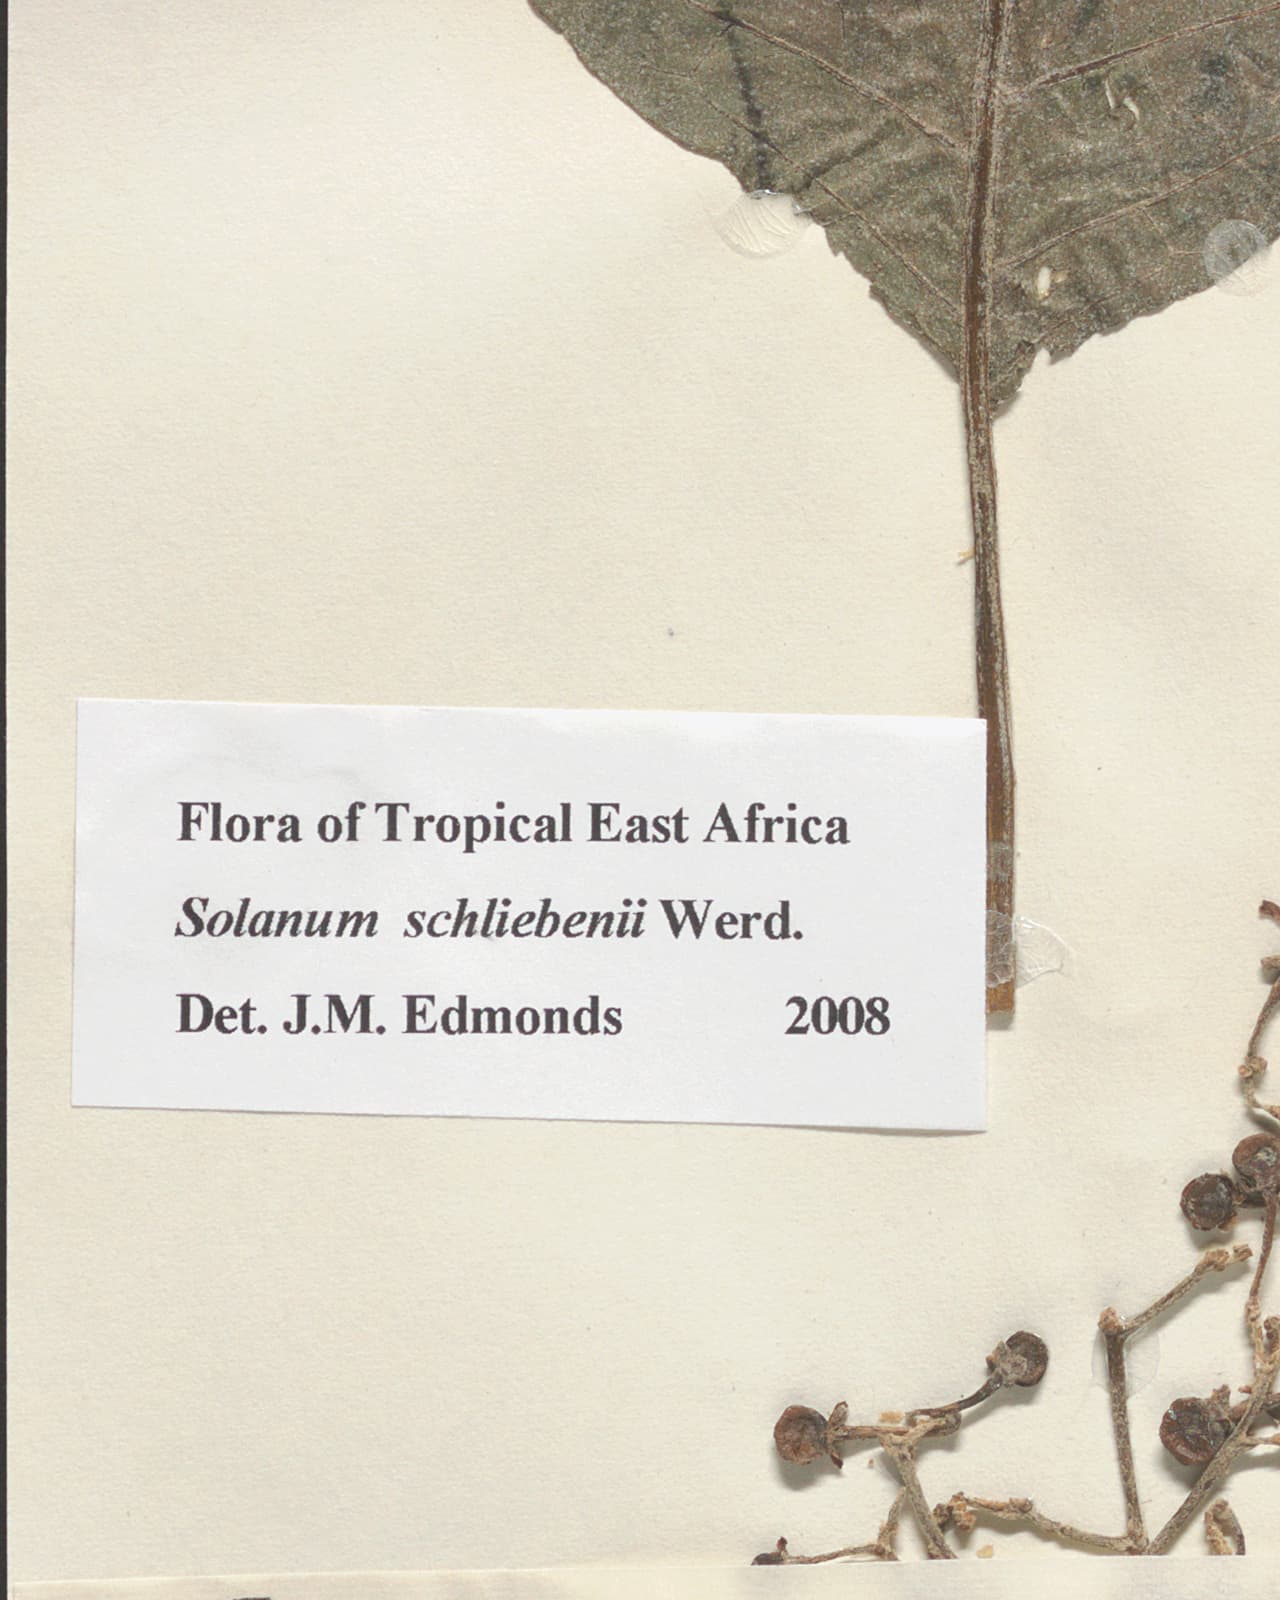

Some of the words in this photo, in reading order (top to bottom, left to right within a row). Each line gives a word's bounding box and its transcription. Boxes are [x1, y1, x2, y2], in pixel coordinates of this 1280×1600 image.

[178, 802, 302, 842] Flora
[318, 802, 366, 842] of
[375, 802, 572, 853] Tropical
[588, 803, 689, 843] East
[703, 803, 850, 844] Africa
[175, 897, 378, 937] Solanum
[404, 898, 647, 938] schliebenii
[660, 900, 803, 940] Werd.
[176, 994, 267, 1034] Det.
[283, 994, 385, 1034] J.M.
[402, 995, 622, 1035] Edmonds
[785, 996, 890, 1035] 2008
